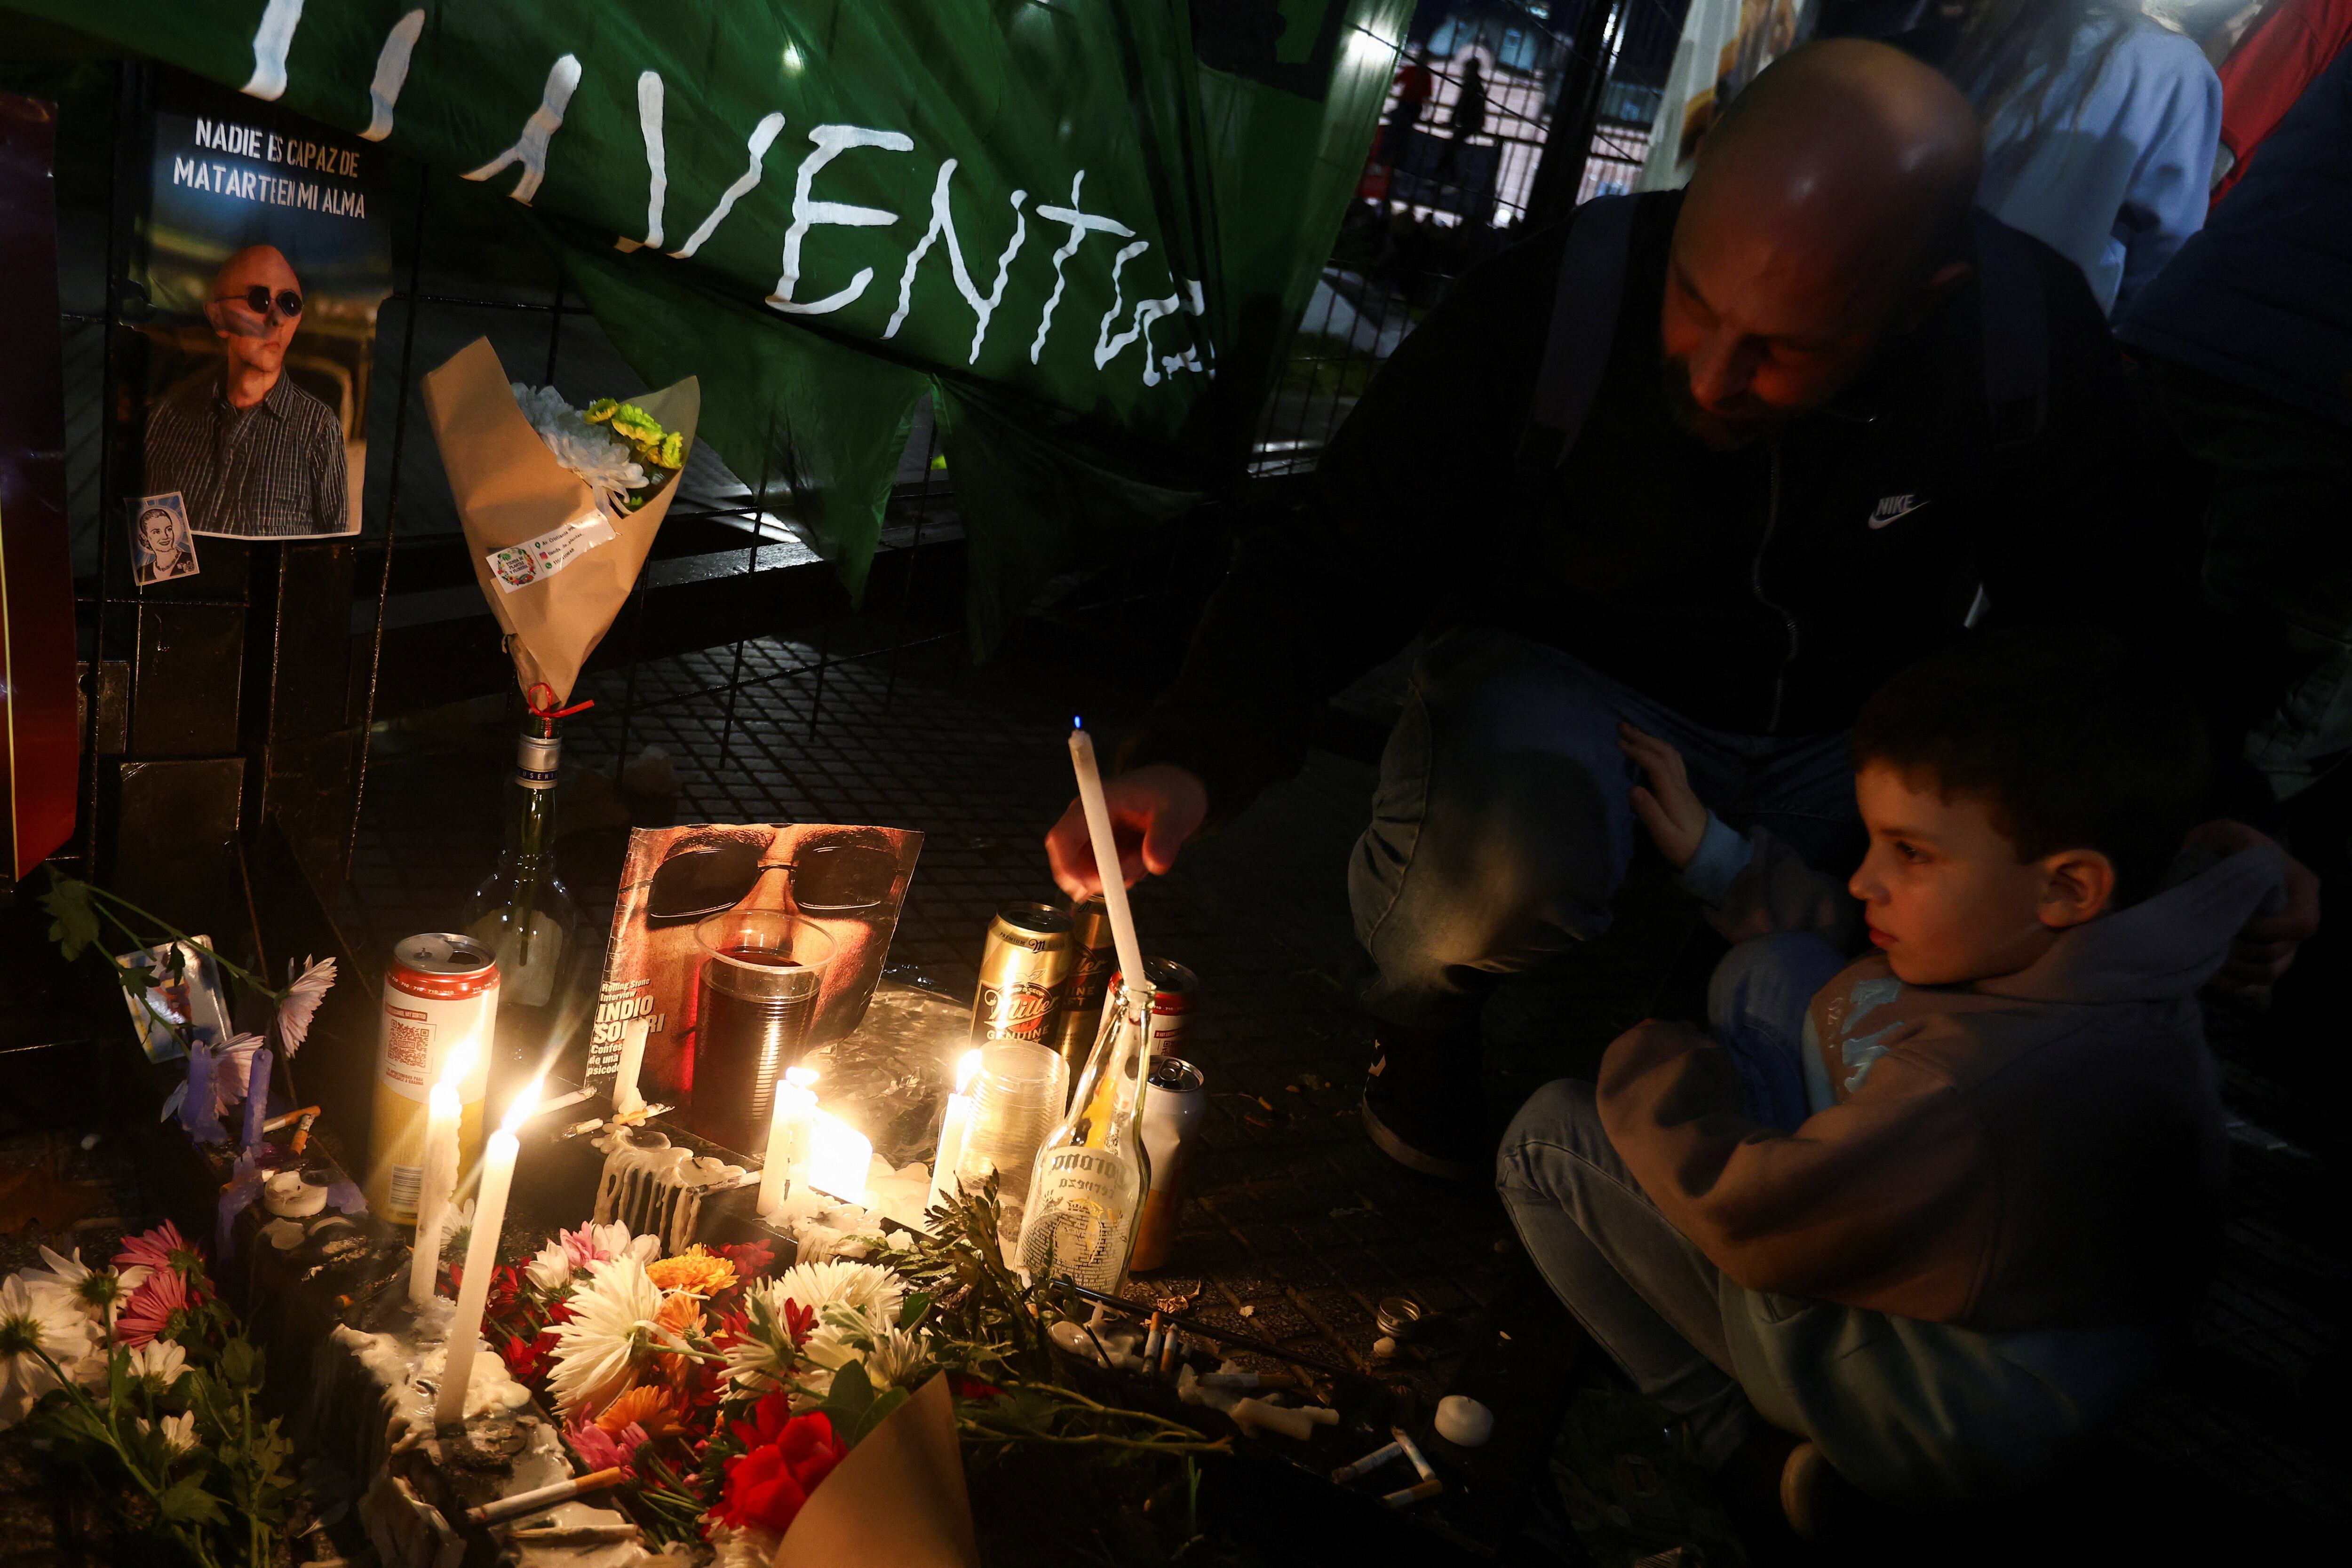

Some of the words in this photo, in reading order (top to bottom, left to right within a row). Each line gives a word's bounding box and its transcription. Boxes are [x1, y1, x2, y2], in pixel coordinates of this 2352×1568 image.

[195, 115, 263, 159] NADIE
[267, 132, 284, 163] ES
[286, 139, 339, 174] CAPAZ
[339, 150, 360, 178] DE
[174, 156, 277, 204] MATARTE
[278, 178, 295, 207] EN
[297, 181, 319, 211] MI
[322, 187, 366, 220] ALMA
[1875, 494, 1916, 516] NIKE
[999, 932, 1025, 946] PREMIUM
[601, 982, 629, 992] Rolling
[630, 978, 650, 989] Stone
[600, 990, 636, 1002] Interview
[596, 995, 654, 1023] INDIO
[984, 989, 1061, 1020] Miller
[986, 1024, 1049, 1040] GENUINE
[590, 1043, 623, 1054] Confes
[588, 1055, 601, 1065] de
[602, 1054, 619, 1064] una
